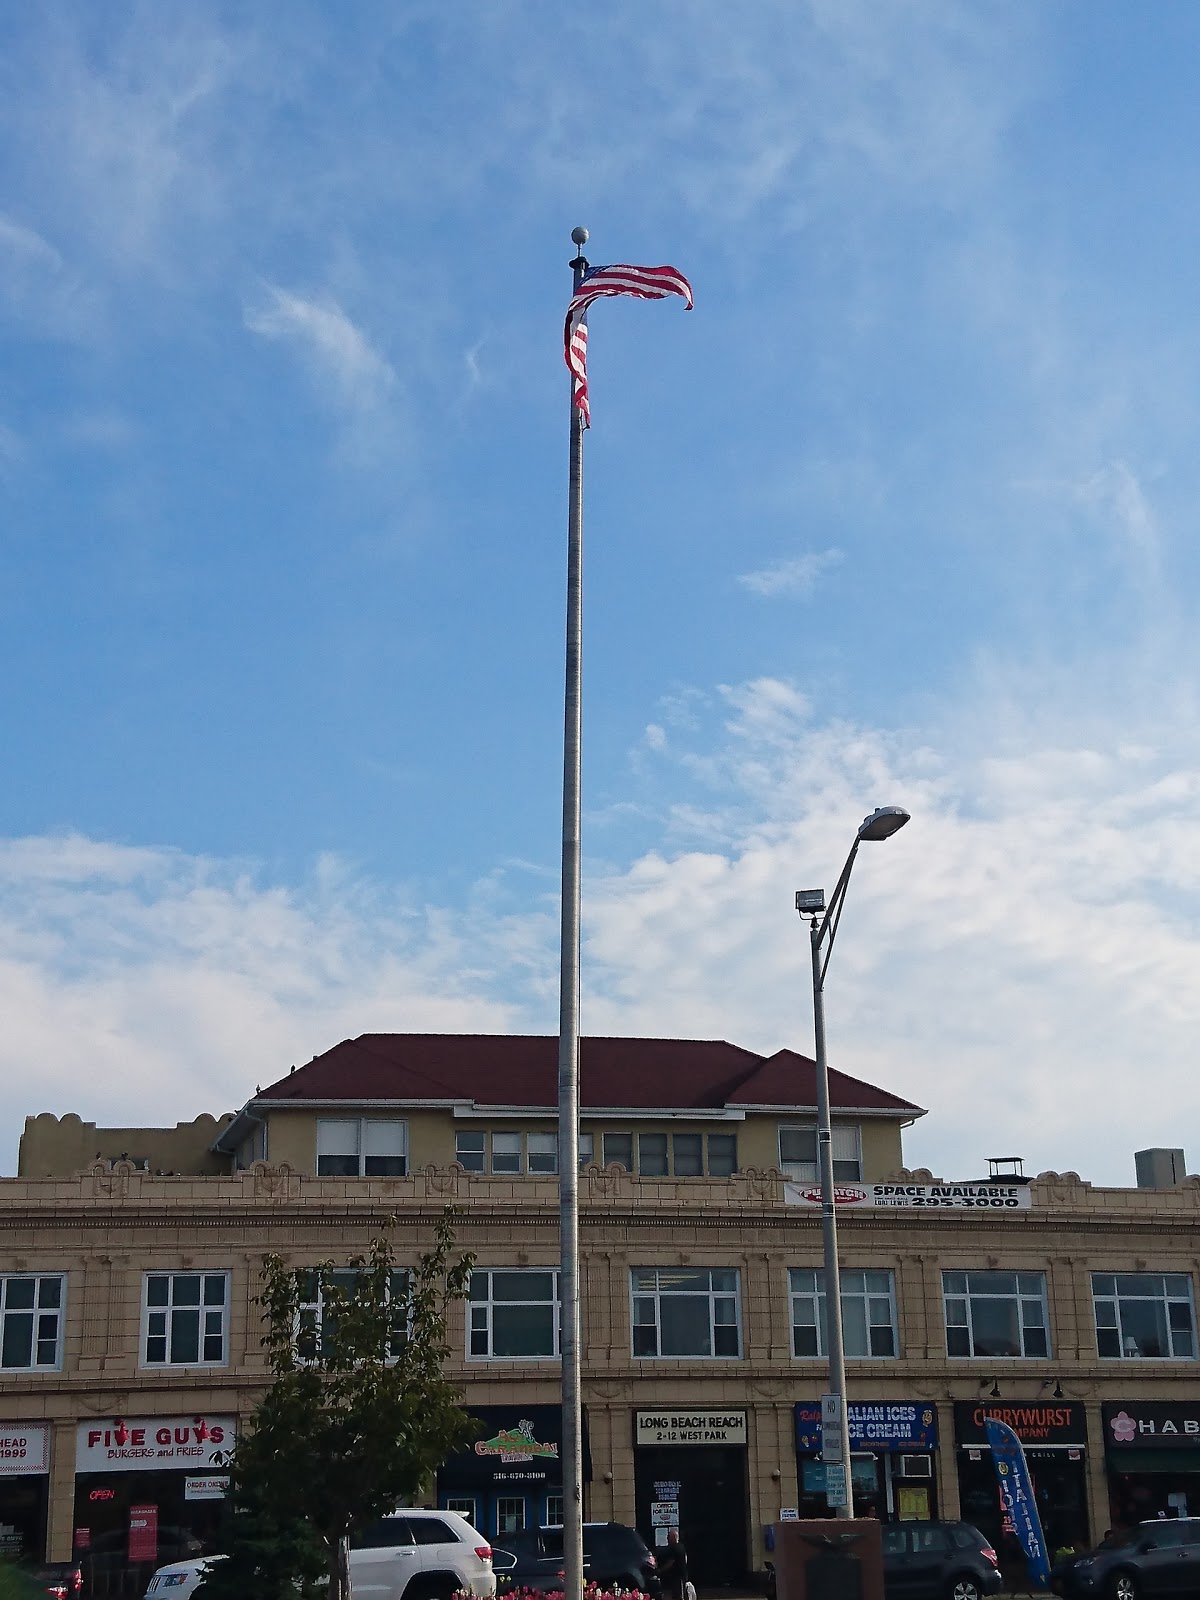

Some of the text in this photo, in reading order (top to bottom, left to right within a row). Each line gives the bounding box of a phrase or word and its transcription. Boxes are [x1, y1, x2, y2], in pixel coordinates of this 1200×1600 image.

[803, 1188, 864, 1199] PUATCH
[873, 1186, 1018, 1198] SPACE AVAILABLE
[912, 1197, 1019, 1208] 295-3000
[827, 1400, 836, 1413] NO
[847, 1406, 883, 1421] ALIAN
[886, 1406, 917, 1421] ICES
[640, 1416, 743, 1429] LONG BEACH REACH
[656, 1431, 727, 1440] 2-12 WEST PARK
[848, 1423, 865, 1438] CE
[866, 1423, 912, 1438] CREAM
[1014, 1428, 1050, 1438] MPANY
[88, 1426, 225, 1448] FIVE GUYS
[107, 1446, 204, 1459] BURGERS and FRIES
[186, 1481, 206, 1489] ORDER
[89, 1490, 115, 1500] OPEN
